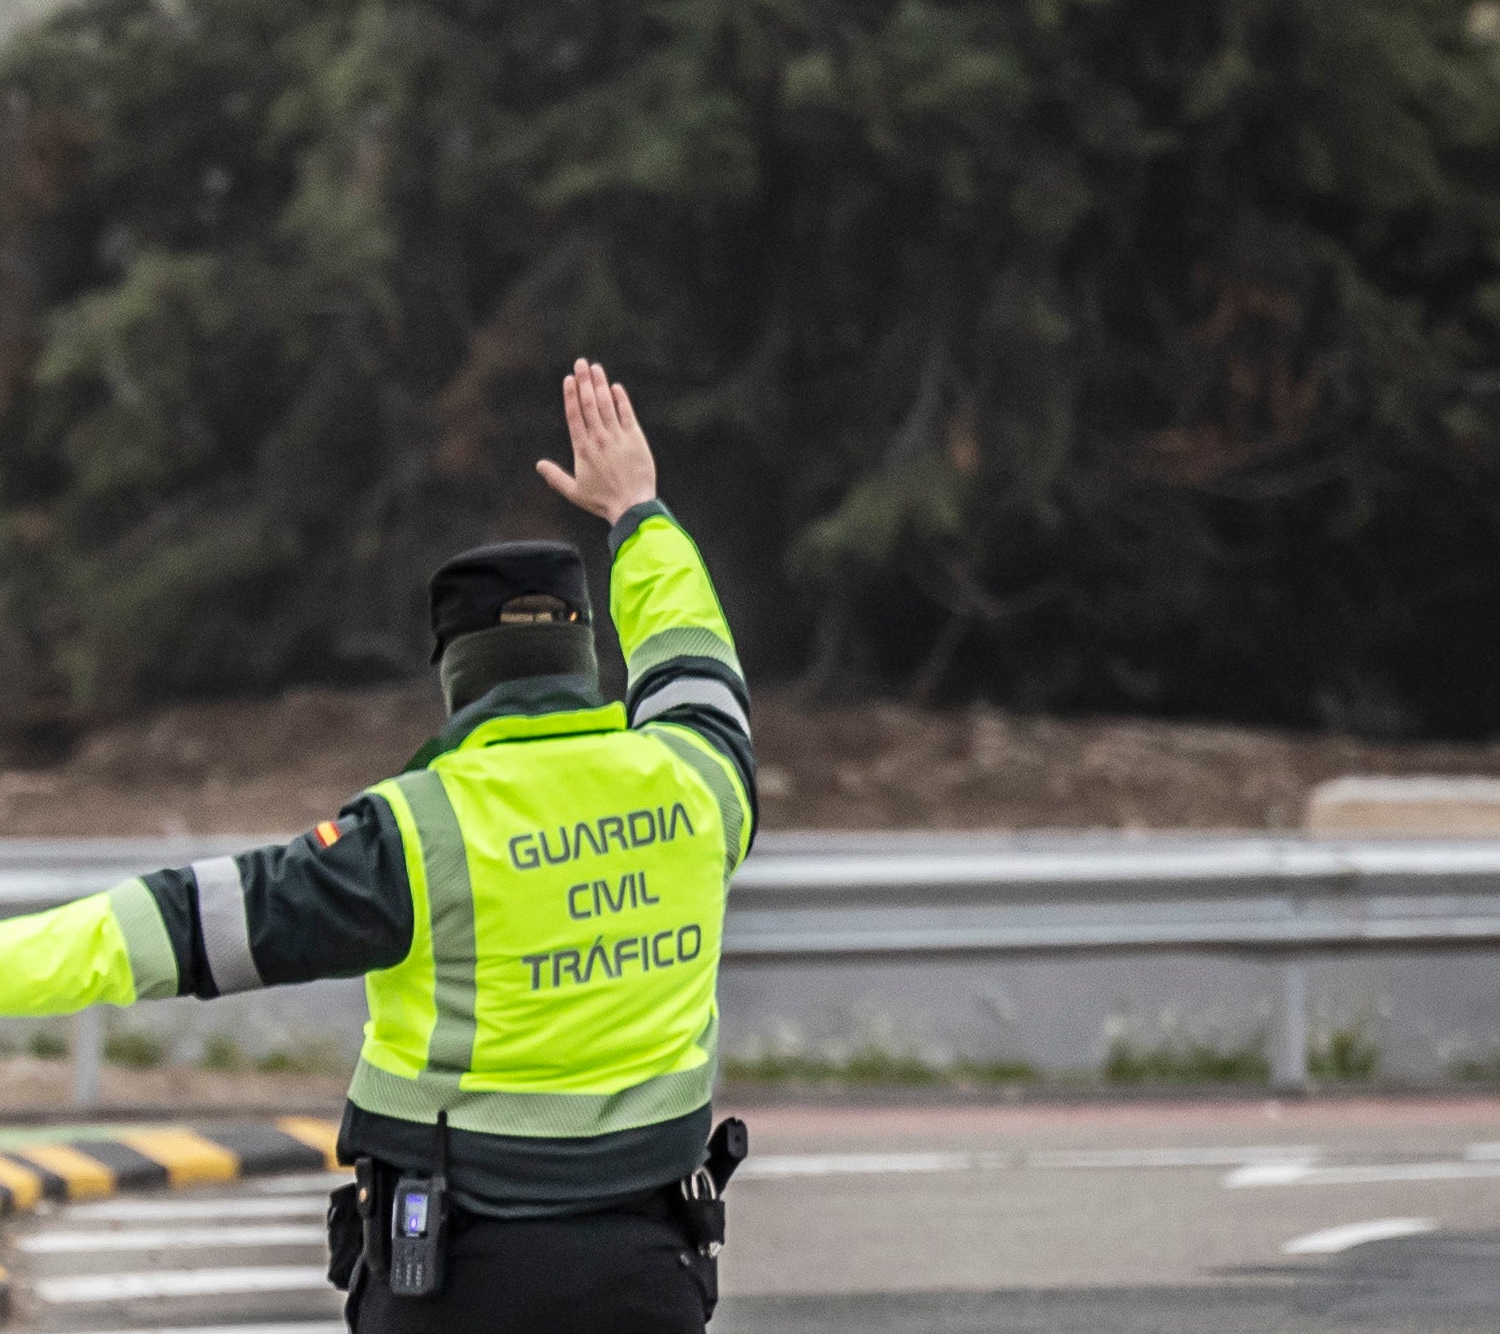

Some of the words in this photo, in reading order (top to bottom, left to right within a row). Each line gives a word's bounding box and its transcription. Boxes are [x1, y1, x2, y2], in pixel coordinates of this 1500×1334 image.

[508, 802, 695, 871] GUARDIA
[567, 871, 660, 920] CIVIL
[520, 924, 701, 991] TRÁFICO
